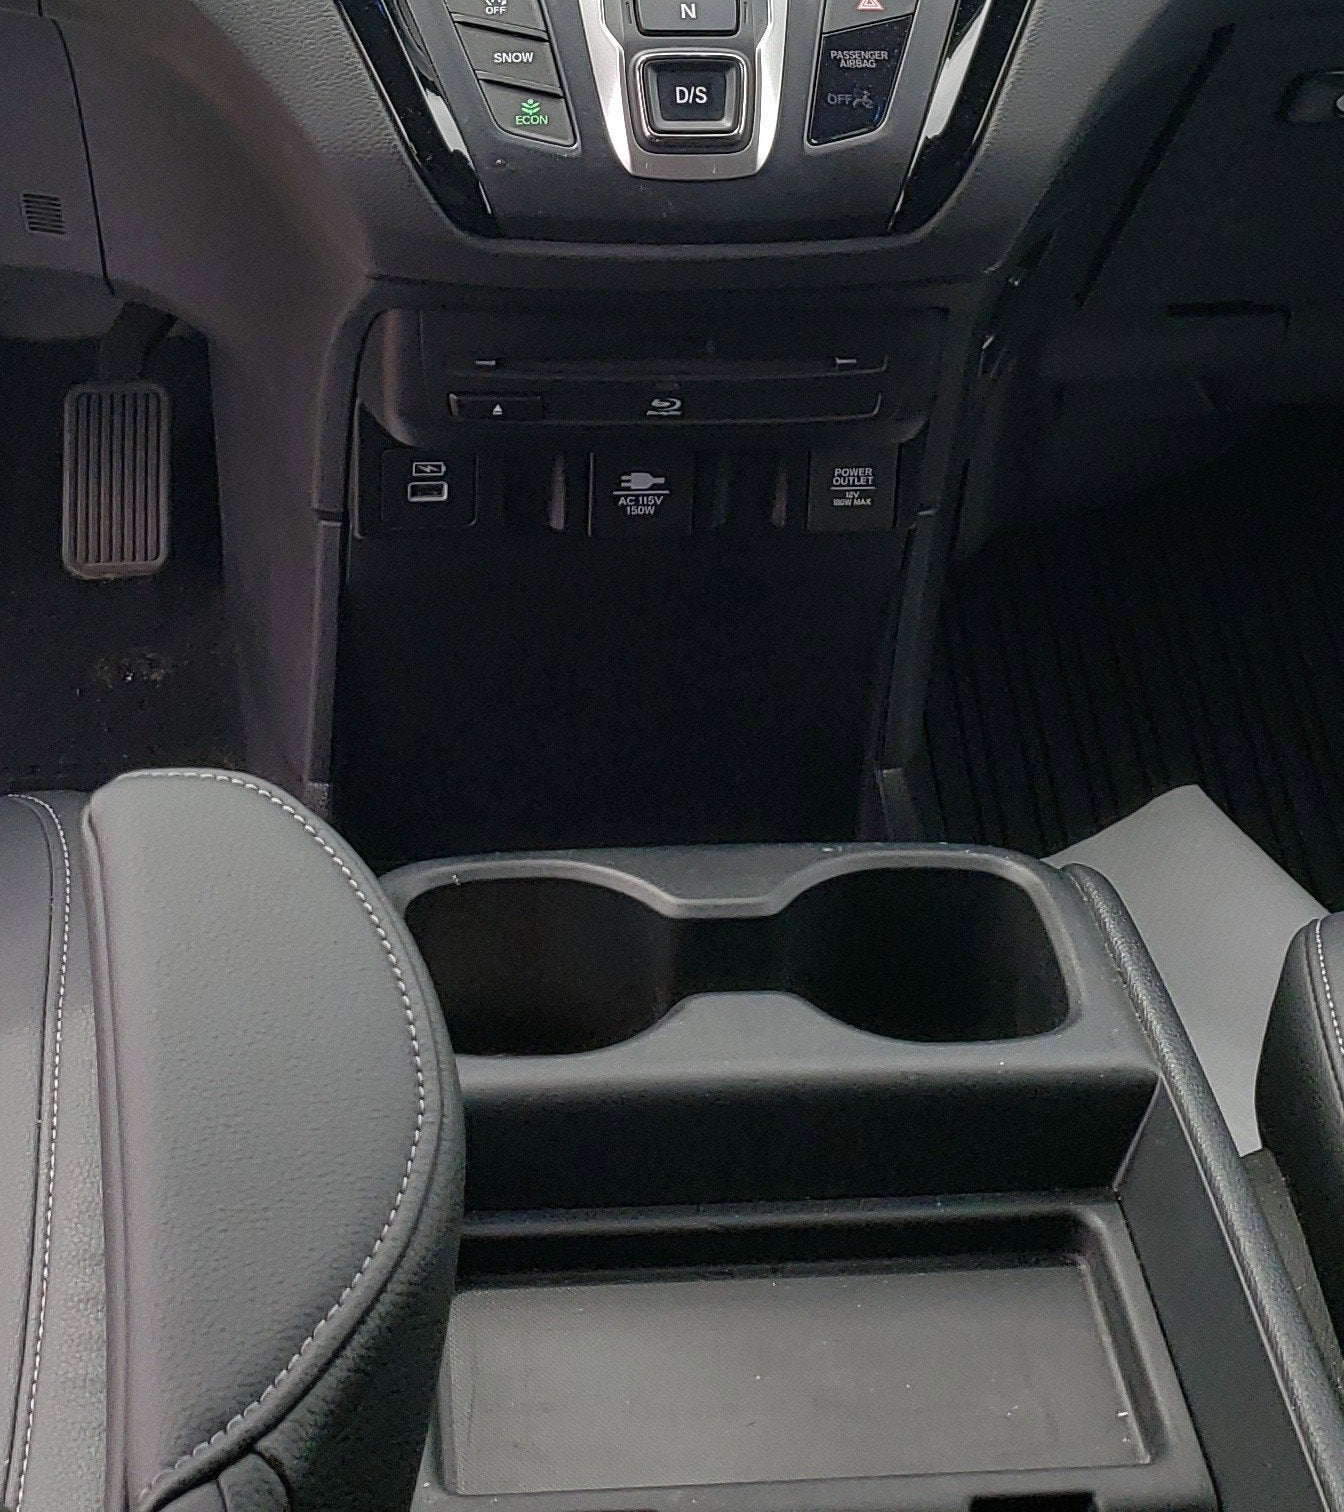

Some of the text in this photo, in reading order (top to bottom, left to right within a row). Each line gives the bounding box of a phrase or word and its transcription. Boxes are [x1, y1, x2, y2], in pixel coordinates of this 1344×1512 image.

[485, 6, 506, 15] OFF
[680, 3, 697, 19] N
[493, 52, 534, 63] SNOW
[830, 50, 889, 60] PASSENGER
[839, 59, 876, 68] AIRBAG
[675, 86, 708, 104] D/S
[827, 93, 853, 104] OFF
[515, 115, 548, 125] ECON
[834, 468, 873, 476] POWER
[832, 476, 874, 485] OUTLET
[618, 495, 664, 505] AC 115V
[626, 506, 655, 515] 150W
